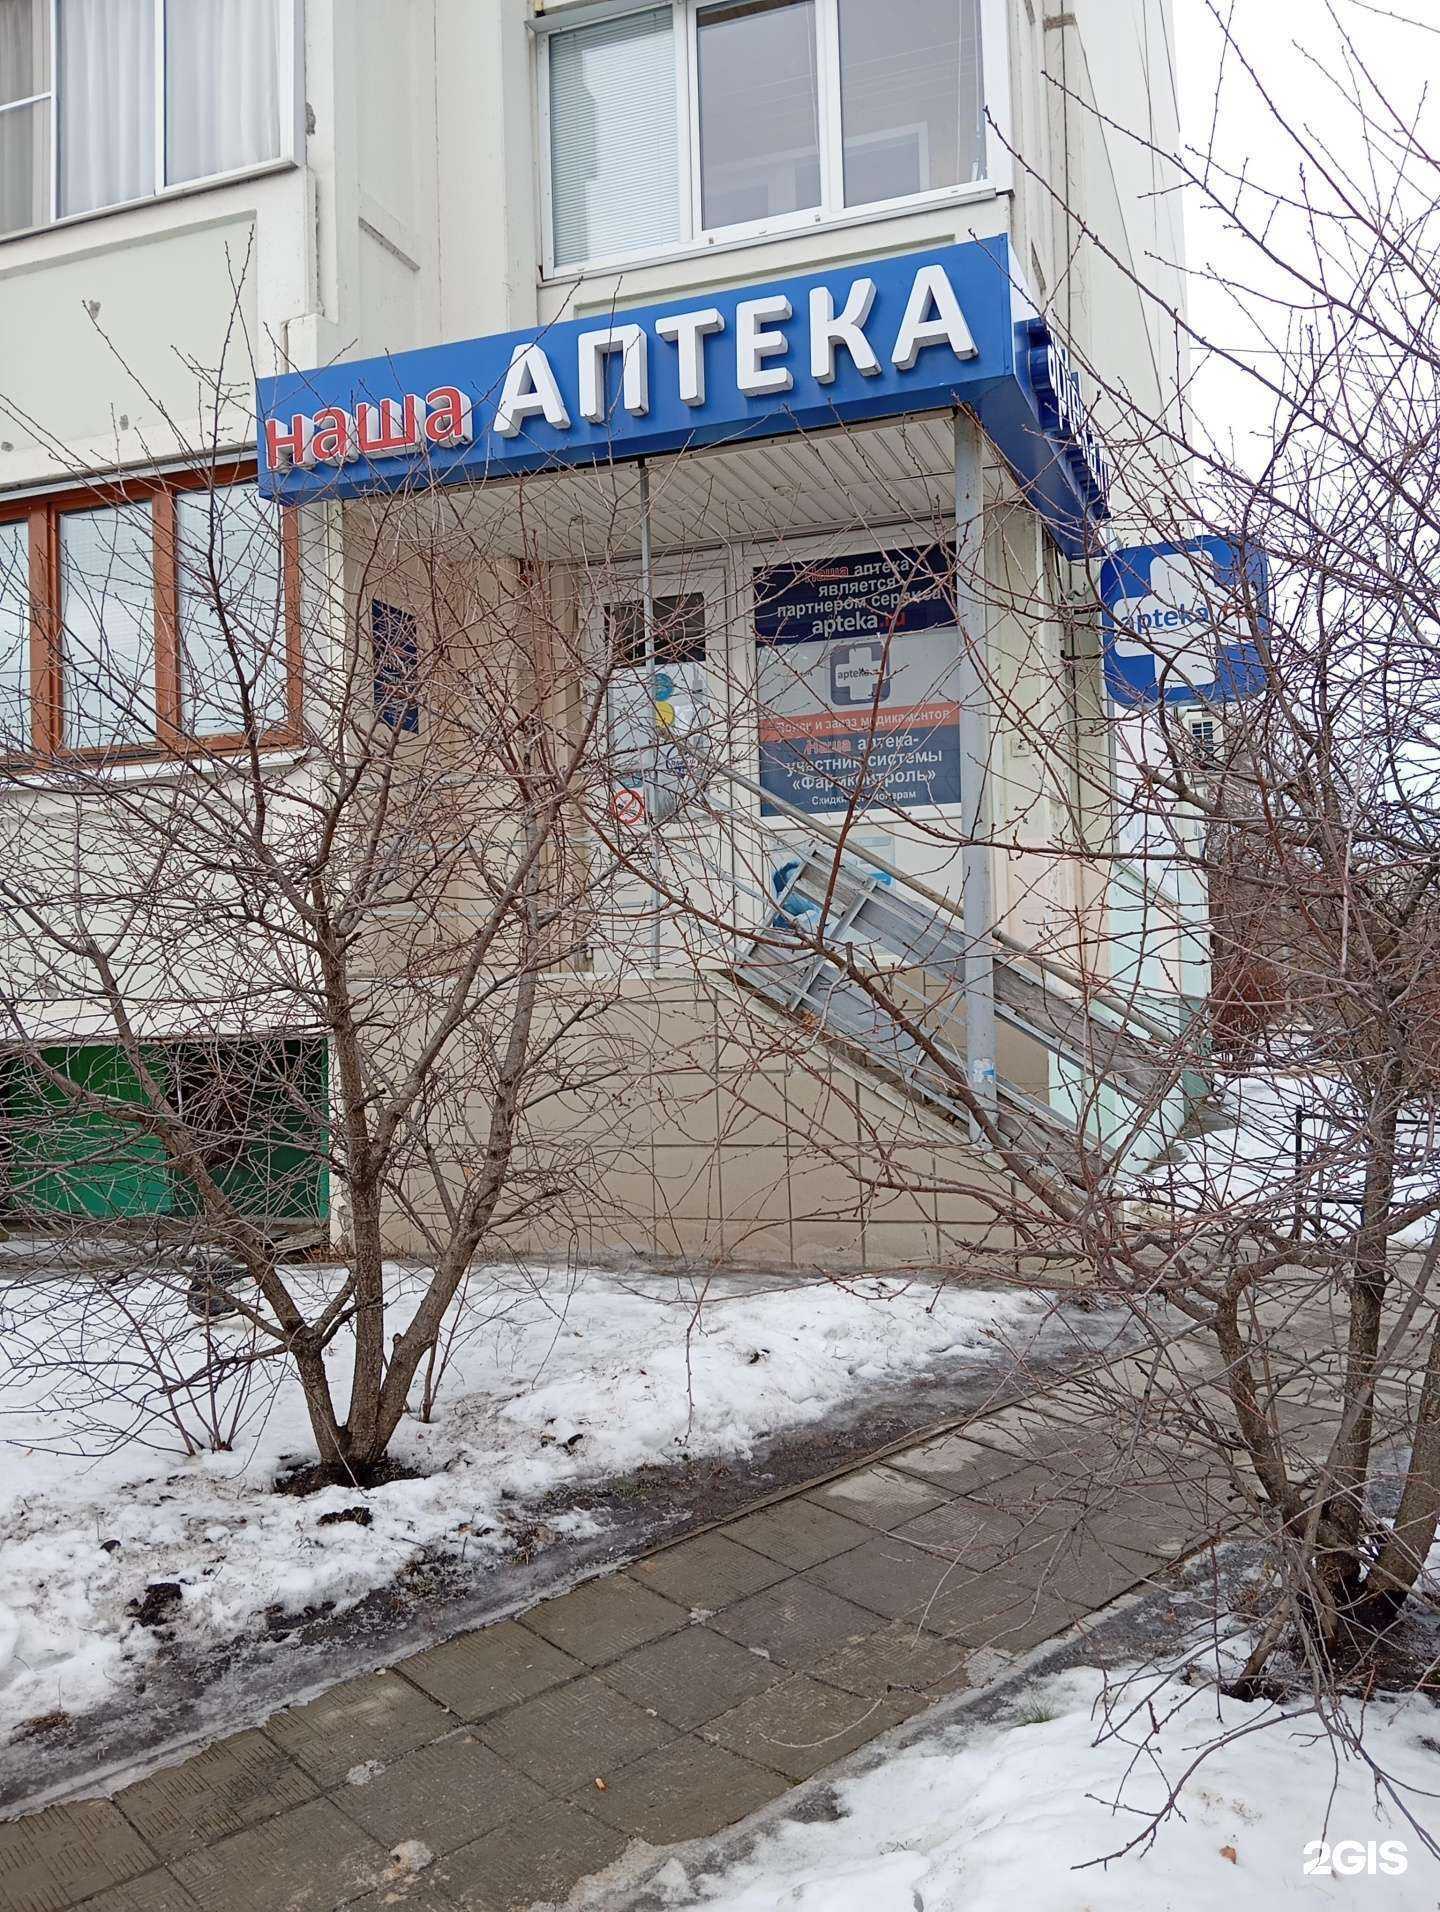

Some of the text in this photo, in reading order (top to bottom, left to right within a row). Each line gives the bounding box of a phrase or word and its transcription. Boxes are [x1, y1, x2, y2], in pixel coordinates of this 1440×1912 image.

[266, 265, 978, 472] наша АПТЕКА
[854, 559, 910, 576] аптека
[818, 576, 896, 597] является
[777, 597, 866, 618] партнером
[861, 709, 951, 728] мдикаментов
[868, 749, 942, 767] системы
